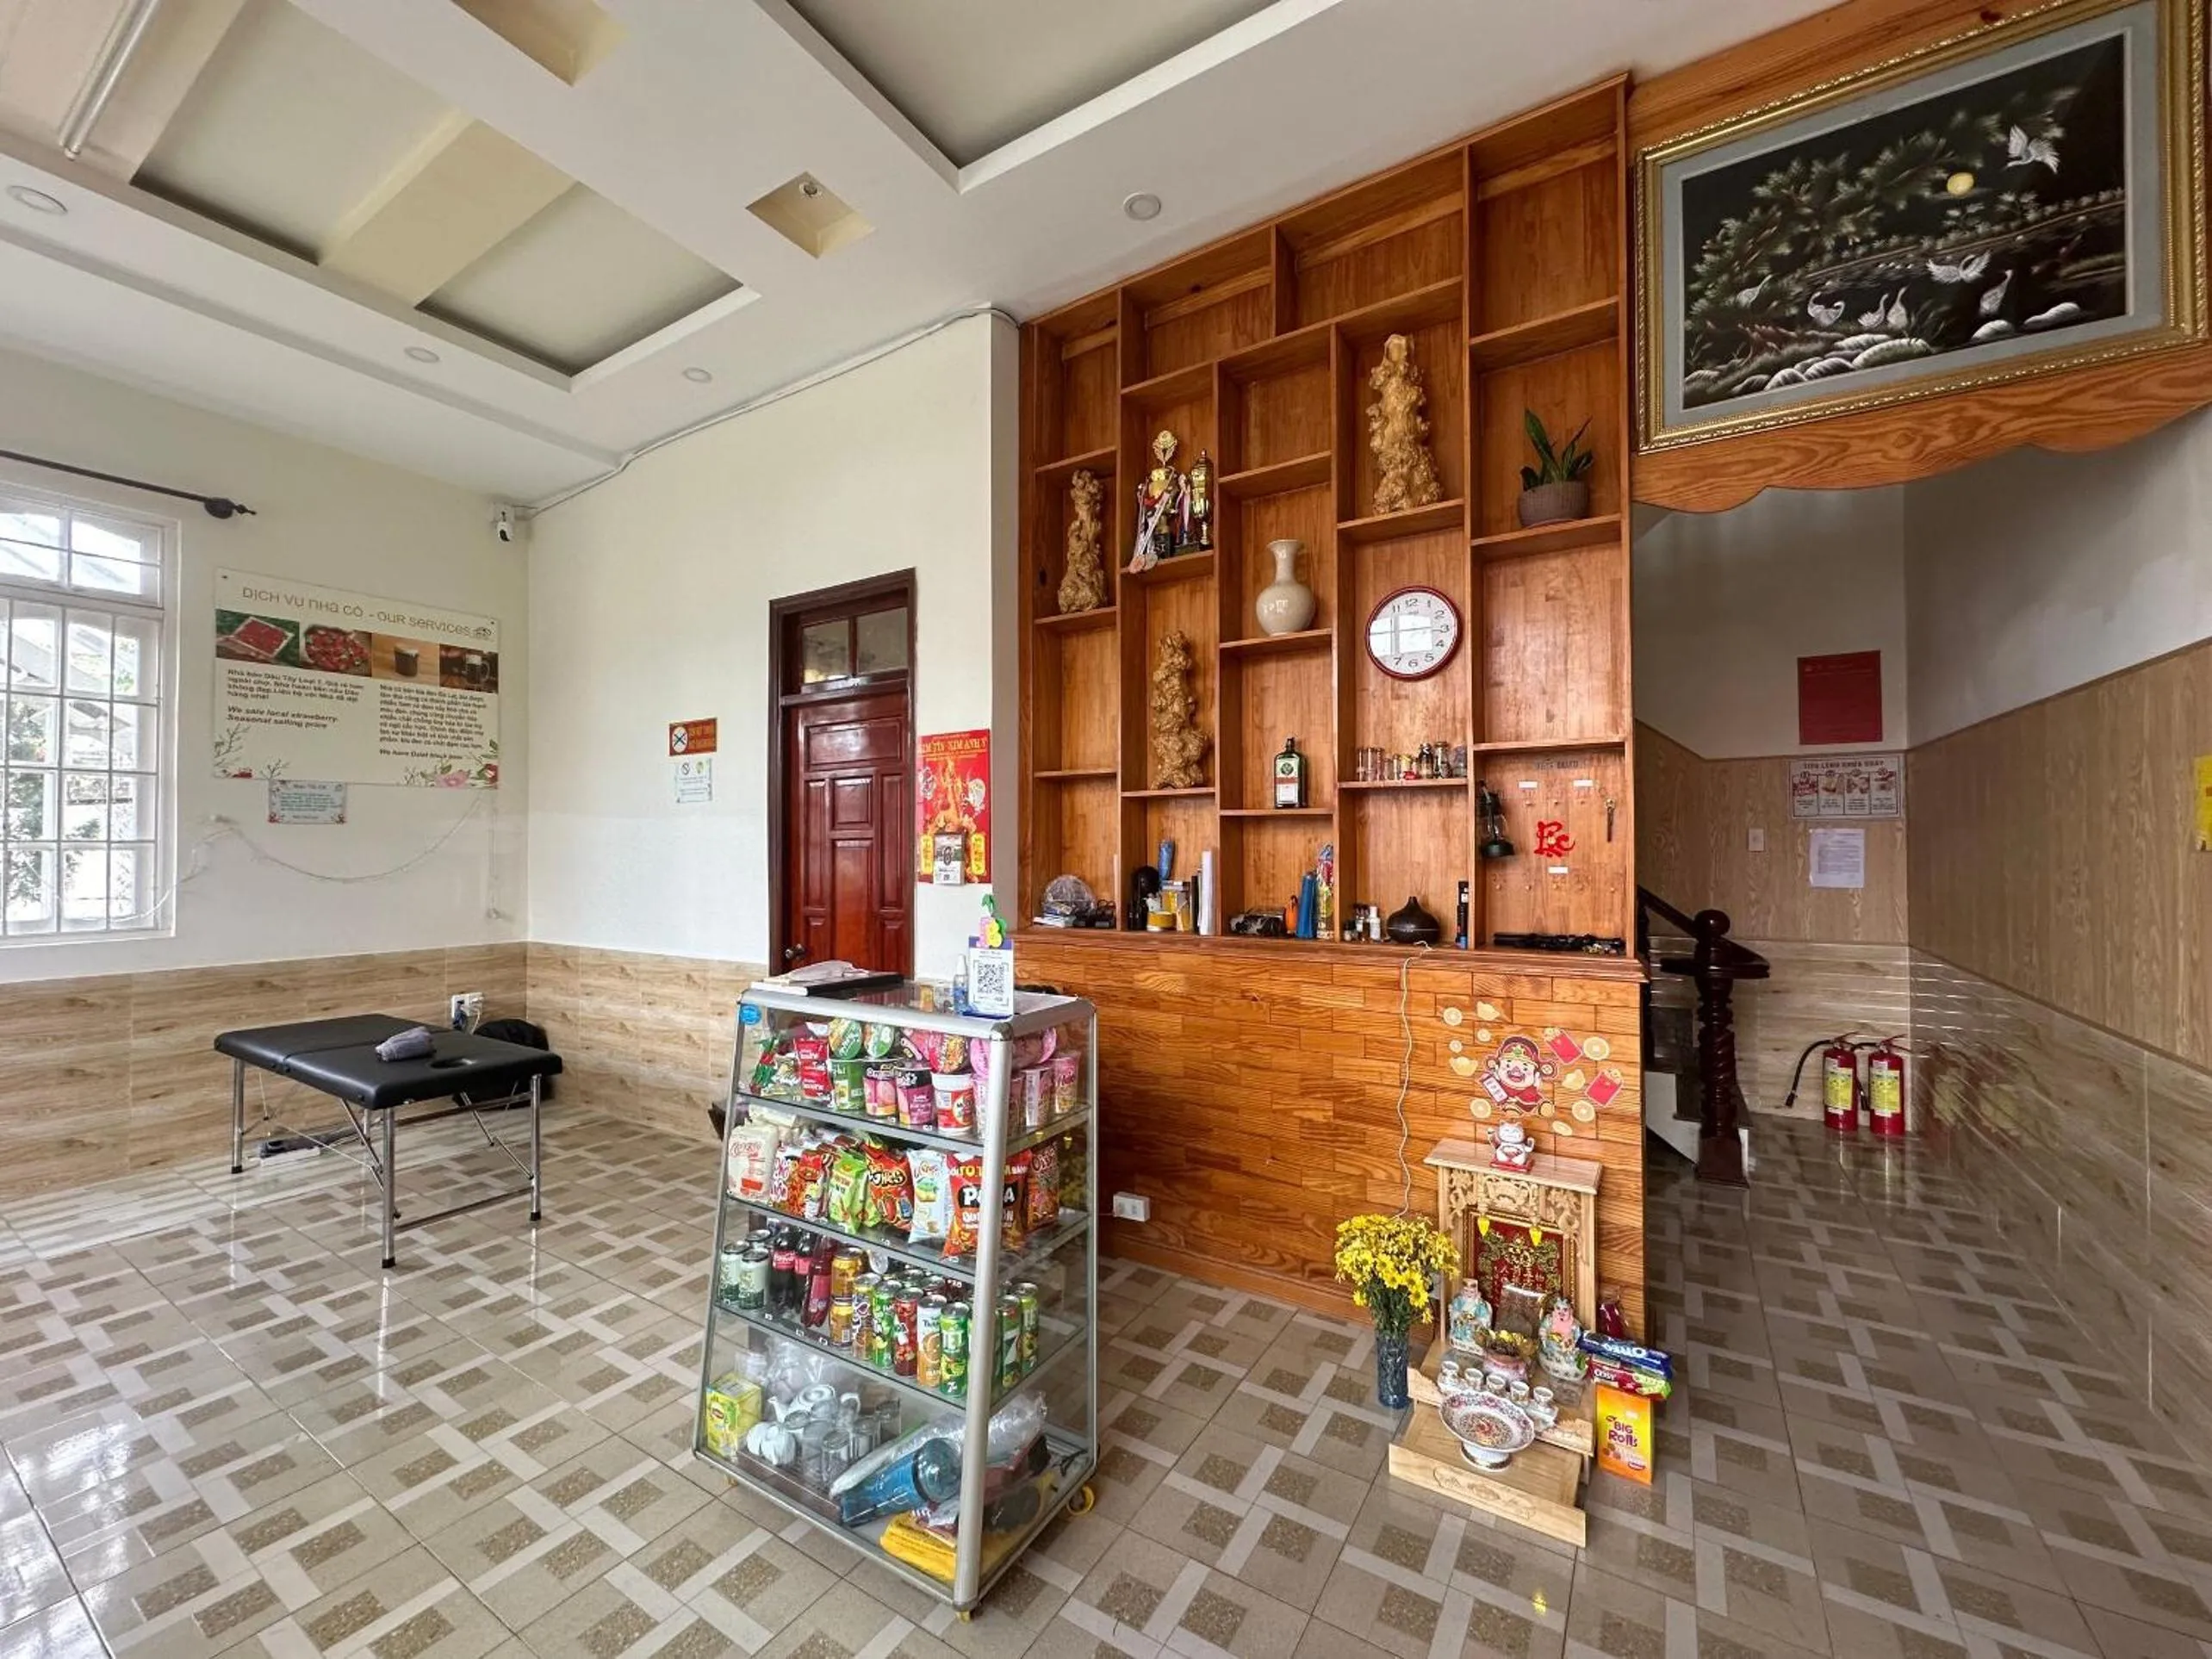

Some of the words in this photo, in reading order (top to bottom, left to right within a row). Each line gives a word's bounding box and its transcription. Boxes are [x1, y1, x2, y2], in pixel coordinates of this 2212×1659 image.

[1405, 598, 1418, 607] 12
[1392, 605, 1401, 613] 11
[1434, 610, 1445, 620] 2
[1439, 624, 1450, 634] 3
[1436, 639, 1445, 649] 4
[1393, 656, 1402, 666] 7
[1407, 658, 1419, 668] 6
[1424, 653, 1434, 663] 5
[1614, 1421, 1633, 1434] BIG
